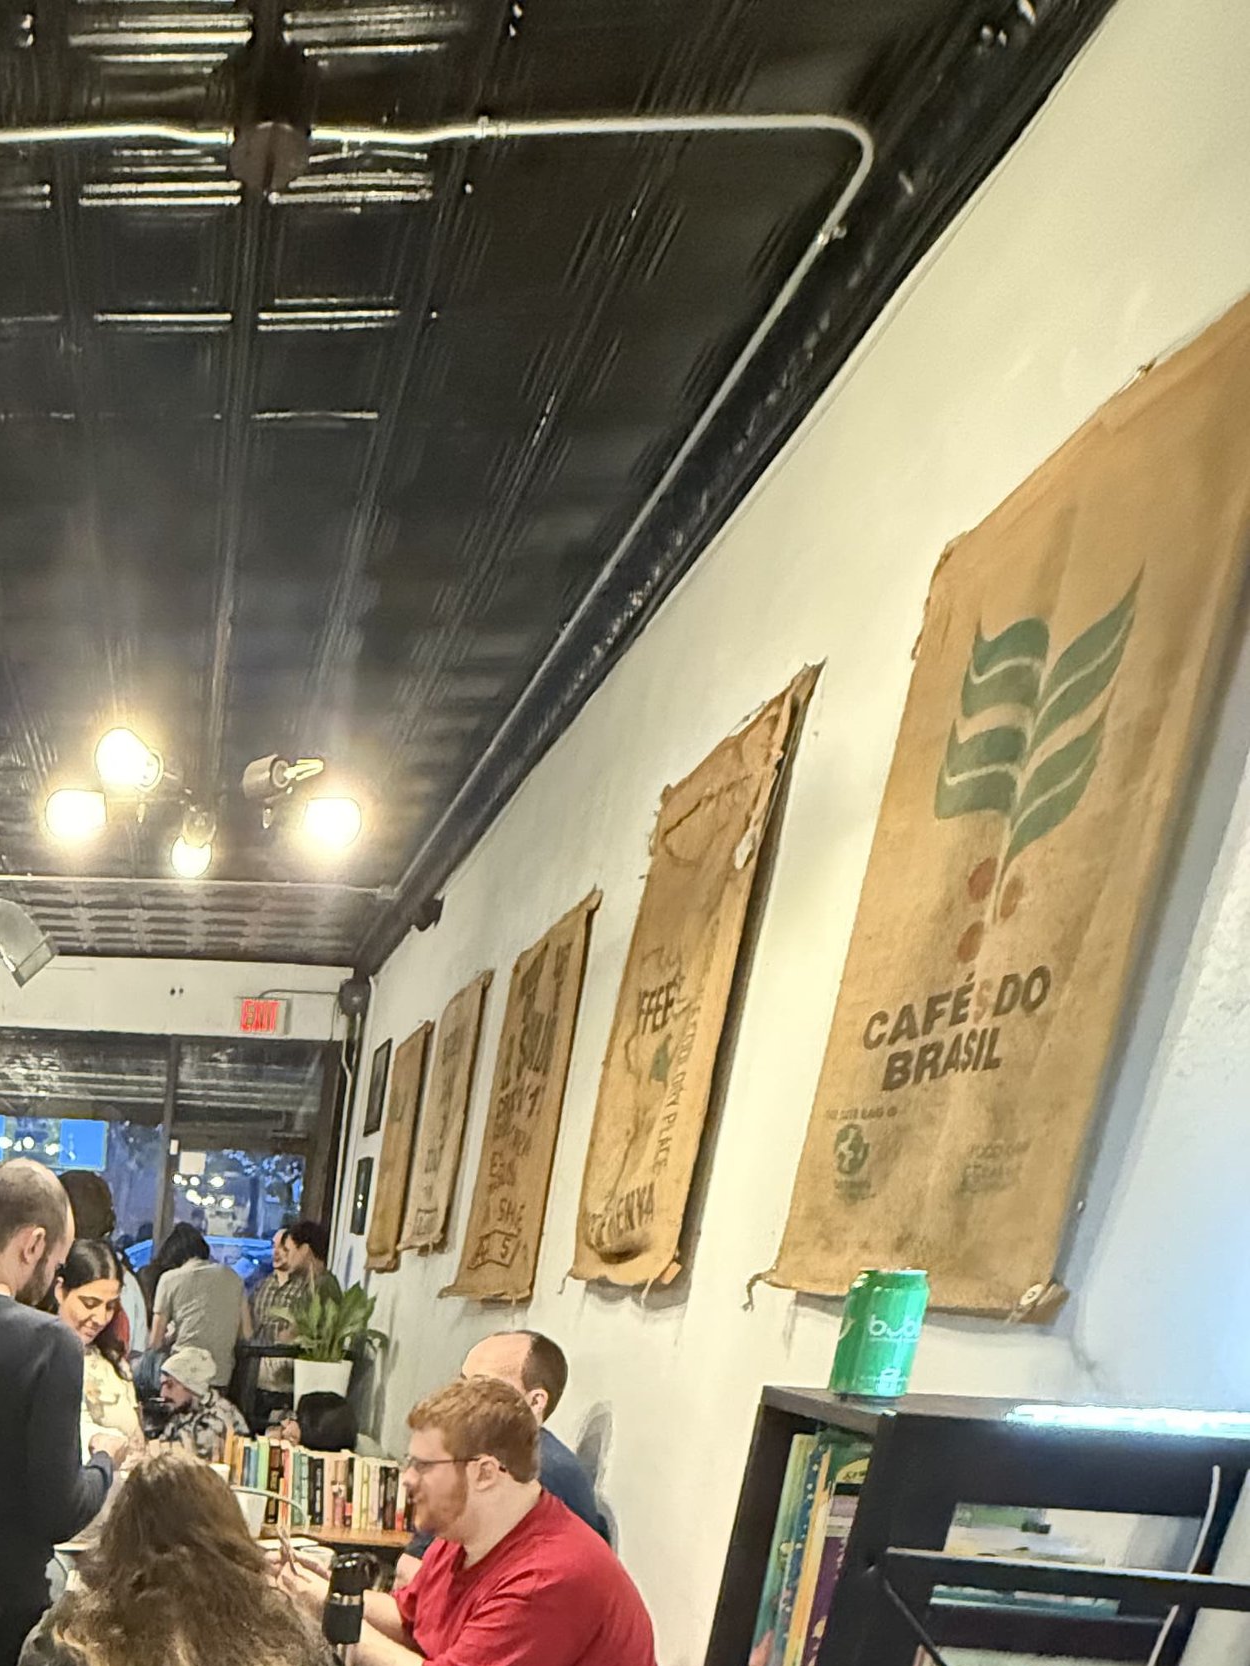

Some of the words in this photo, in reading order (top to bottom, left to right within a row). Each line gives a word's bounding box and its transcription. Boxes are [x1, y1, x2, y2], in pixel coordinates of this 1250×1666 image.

[240, 999, 280, 1034] EXIT
[992, 965, 1052, 1018] DO
[881, 1027, 1003, 1091] BRASIL
